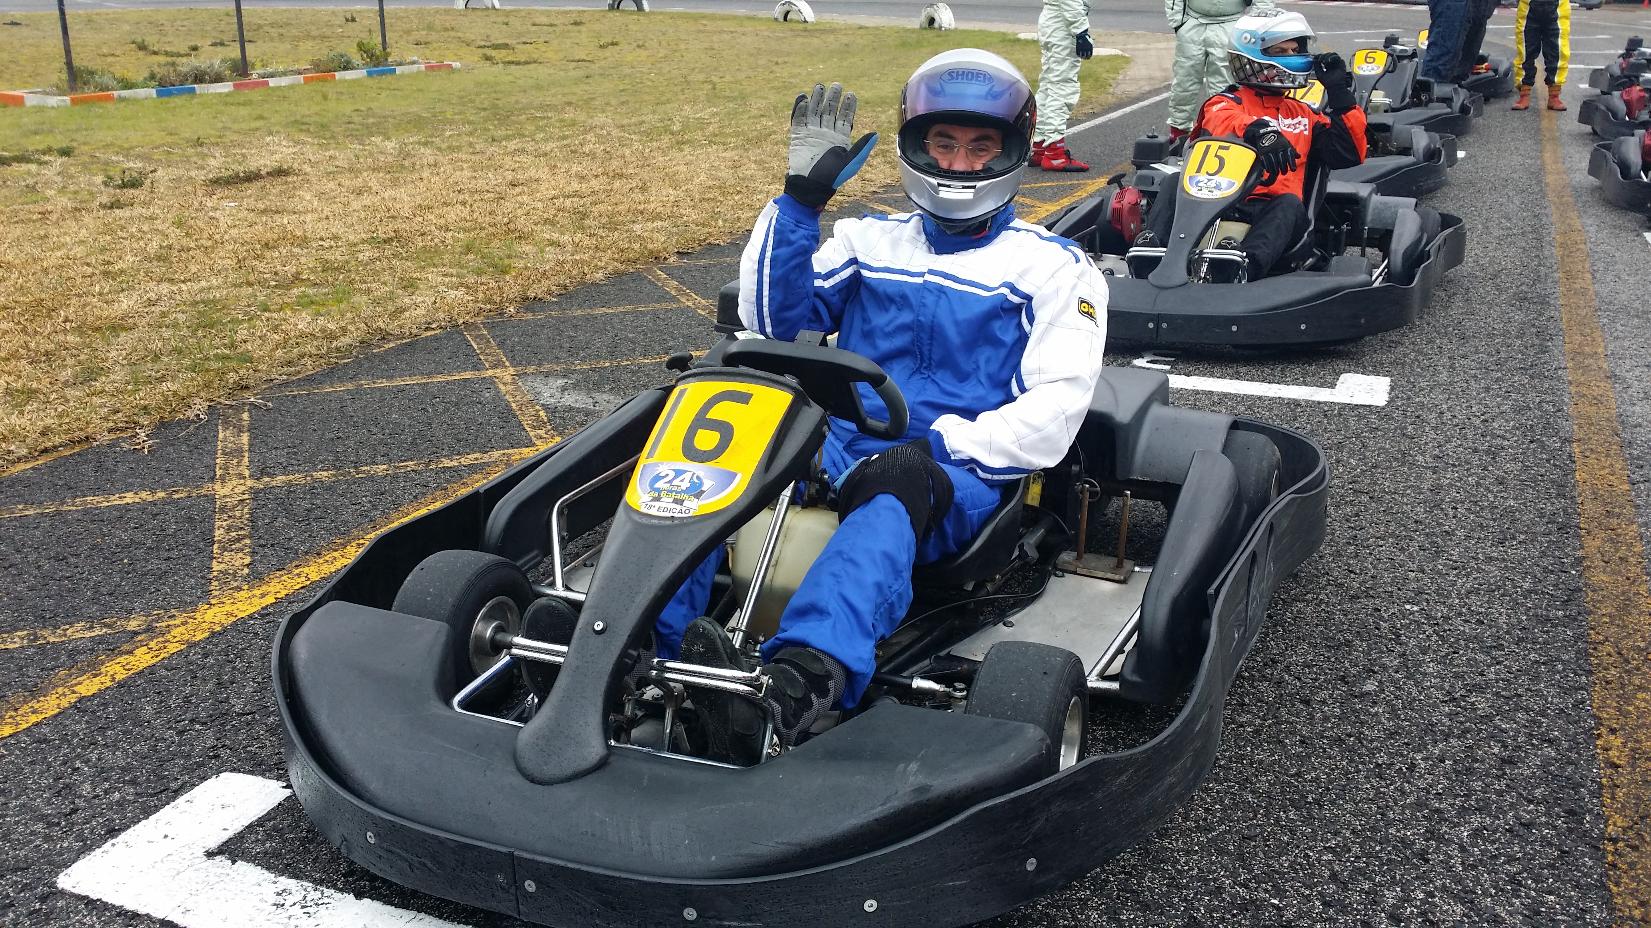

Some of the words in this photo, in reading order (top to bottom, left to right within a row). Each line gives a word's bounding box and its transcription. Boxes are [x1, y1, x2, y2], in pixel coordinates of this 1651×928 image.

[1364, 51, 1377, 64] 6
[947, 70, 989, 83] SHOEI
[1195, 144, 1232, 177] 15
[646, 387, 754, 464] 16
